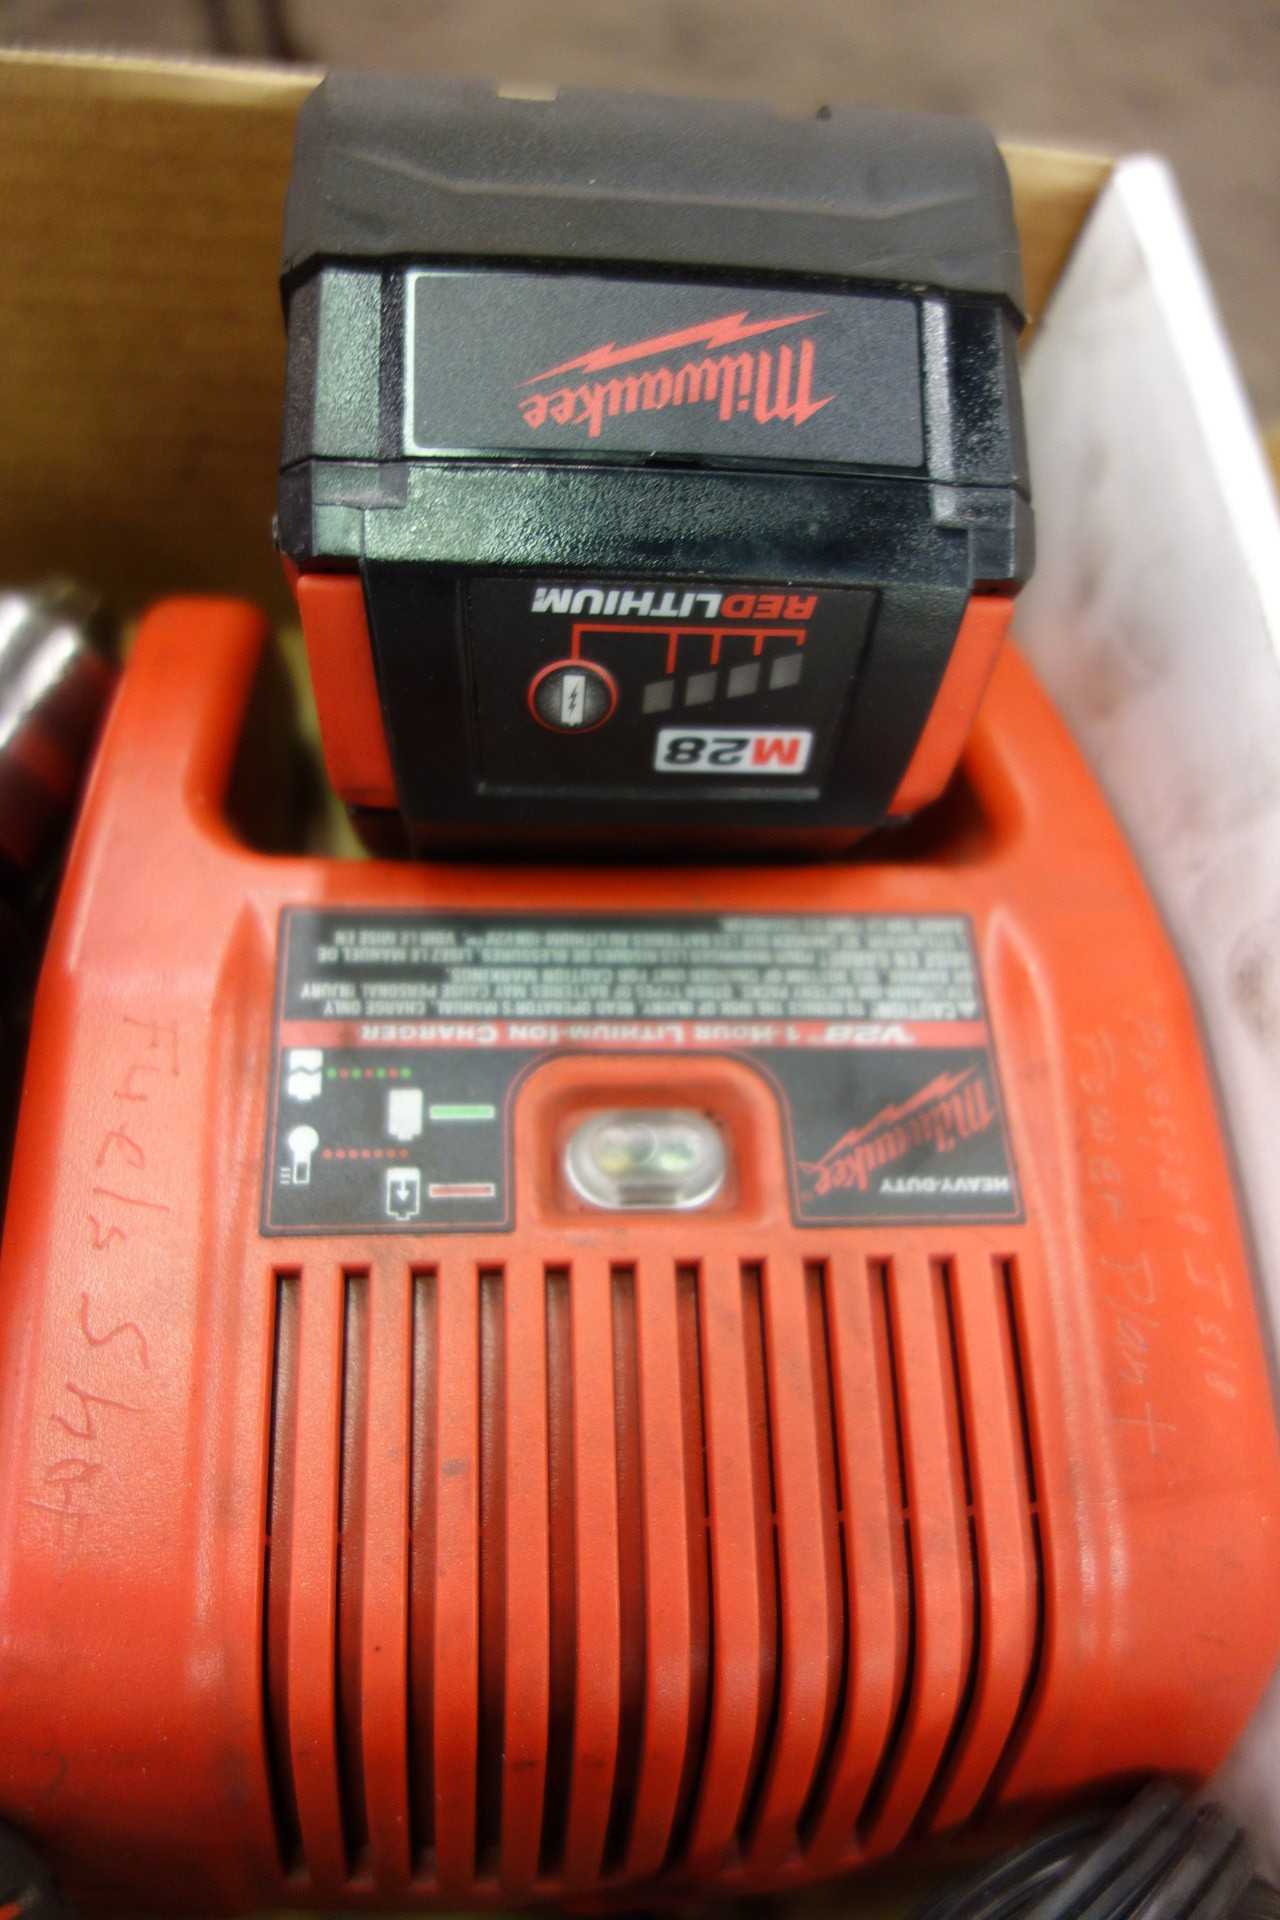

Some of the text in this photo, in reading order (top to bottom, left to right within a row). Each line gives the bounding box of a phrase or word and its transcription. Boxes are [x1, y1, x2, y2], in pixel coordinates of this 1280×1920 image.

[518, 338, 834, 438] Milwaukee
[531, 587, 817, 619] REDLITHIUM
[664, 736, 801, 767] M28
[814, 1078, 992, 1196] Milwaukee
[880, 1176, 1009, 1195] HEAVY-DUTY
